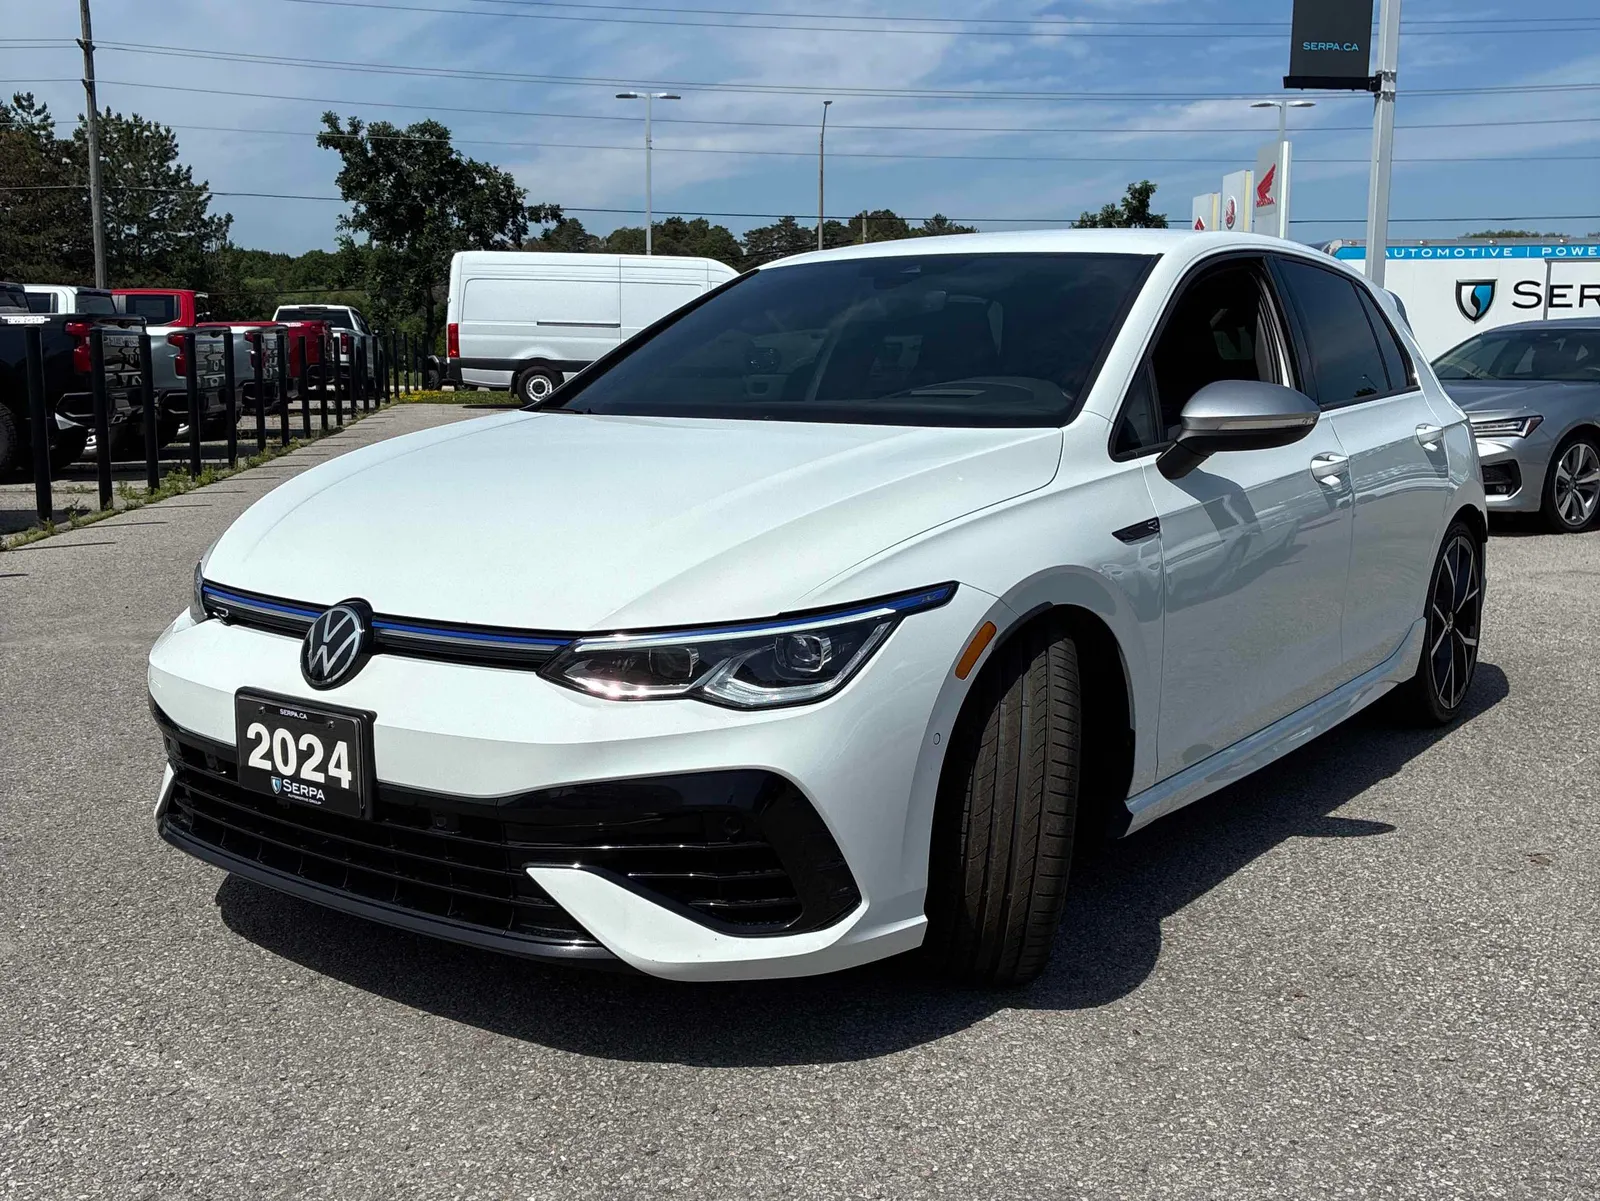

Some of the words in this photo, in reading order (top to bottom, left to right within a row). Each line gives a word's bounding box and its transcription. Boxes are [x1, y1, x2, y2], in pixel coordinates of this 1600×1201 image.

[1302, 41, 1360, 52] SERPA.CA
[279, 708, 308, 720] SERPA.CA
[246, 722, 352, 790] 2024
